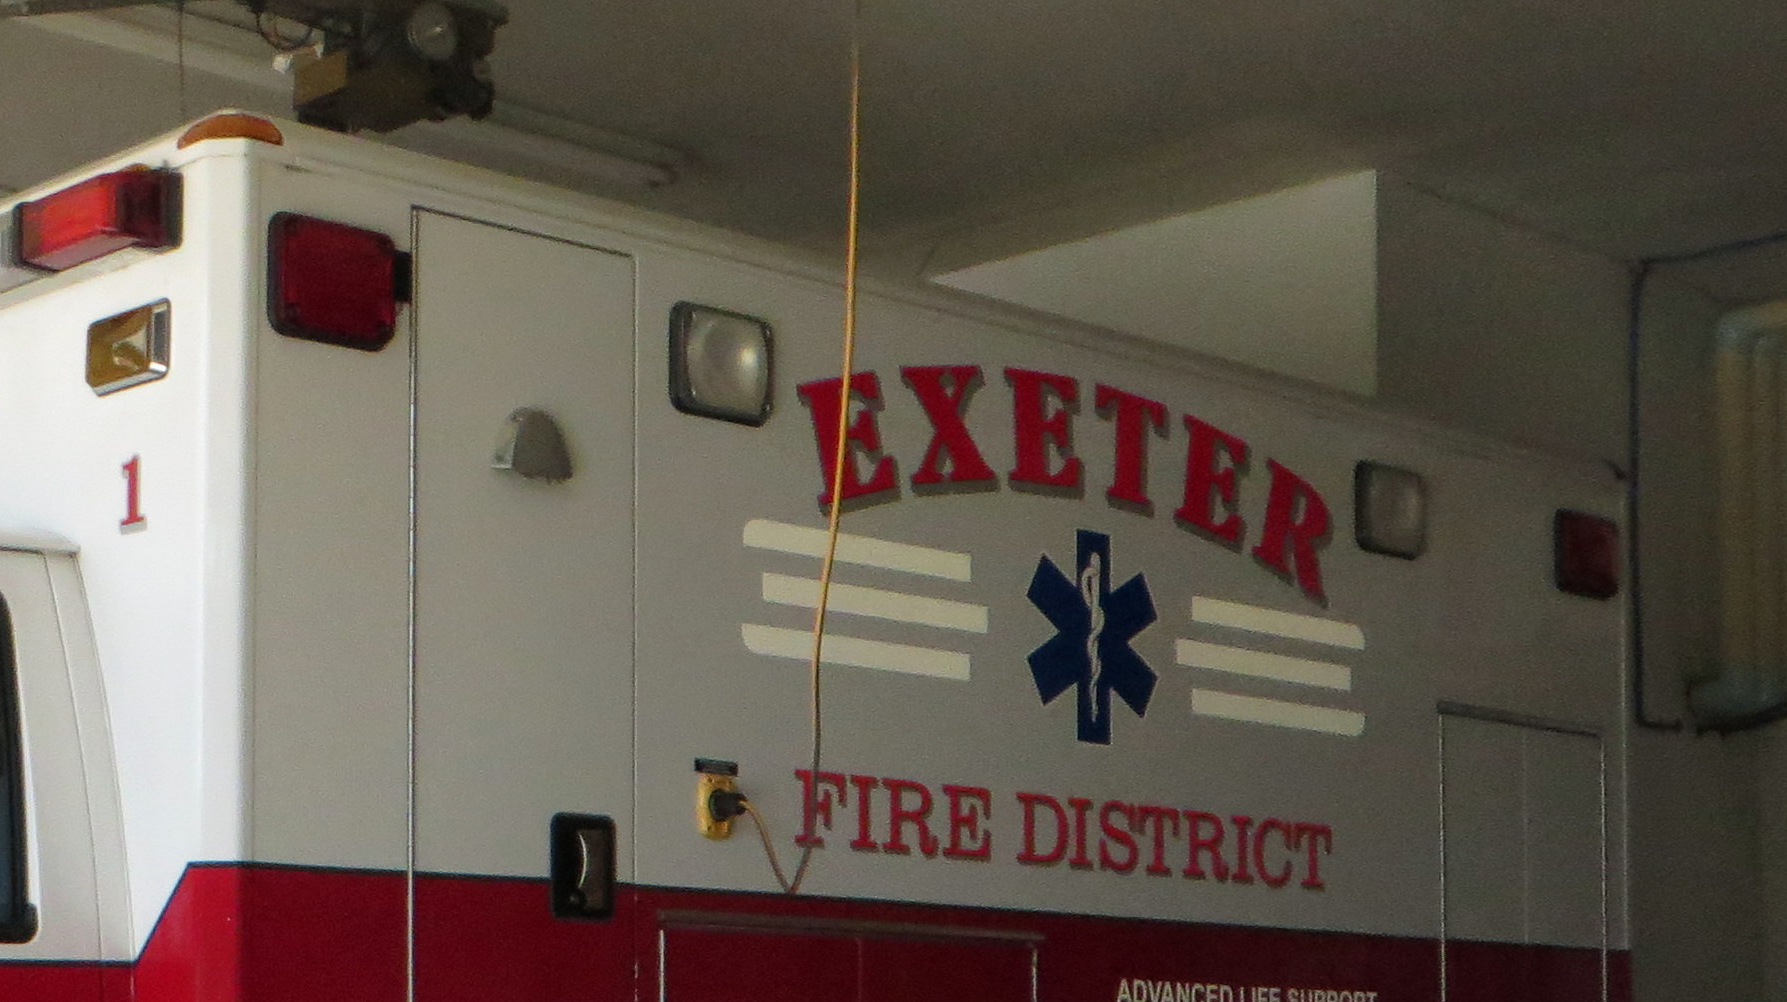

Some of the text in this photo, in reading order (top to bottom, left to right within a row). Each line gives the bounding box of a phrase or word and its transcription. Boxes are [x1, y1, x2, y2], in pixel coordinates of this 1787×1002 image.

[120, 453, 148, 534] 1
[796, 364, 1333, 608] EXETER
[794, 768, 1333, 891] FIRE DISTRICT
